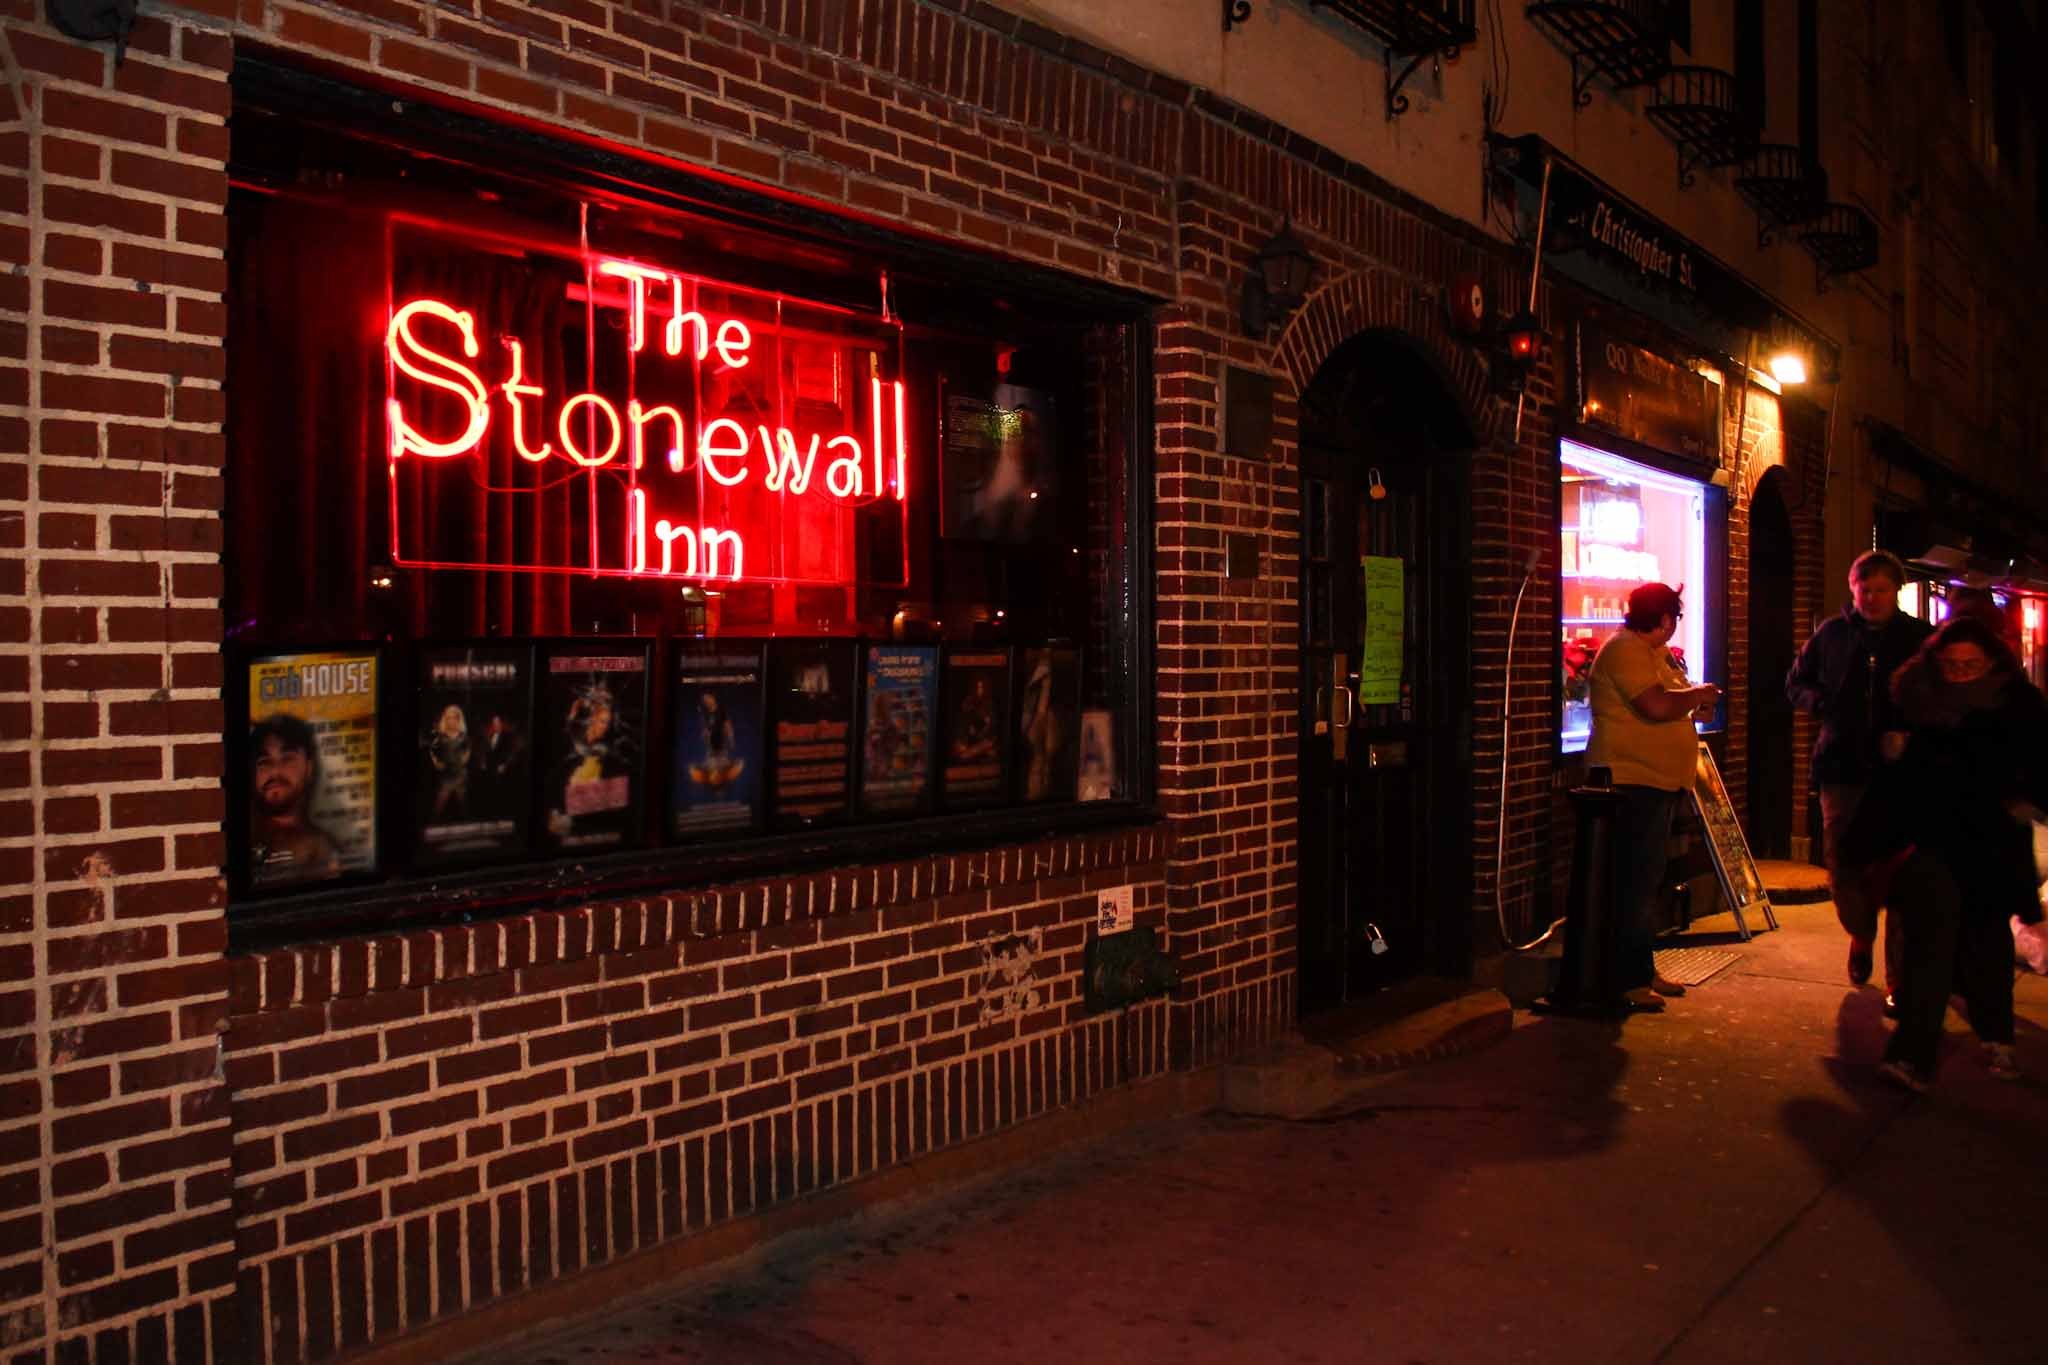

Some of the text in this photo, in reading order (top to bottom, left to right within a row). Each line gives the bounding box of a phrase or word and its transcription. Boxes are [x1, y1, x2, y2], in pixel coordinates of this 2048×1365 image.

[1591, 201, 1674, 279] Christopher
[600, 258, 750, 368] The
[388, 300, 904, 501] Stonewall
[632, 487, 744, 582] Inn
